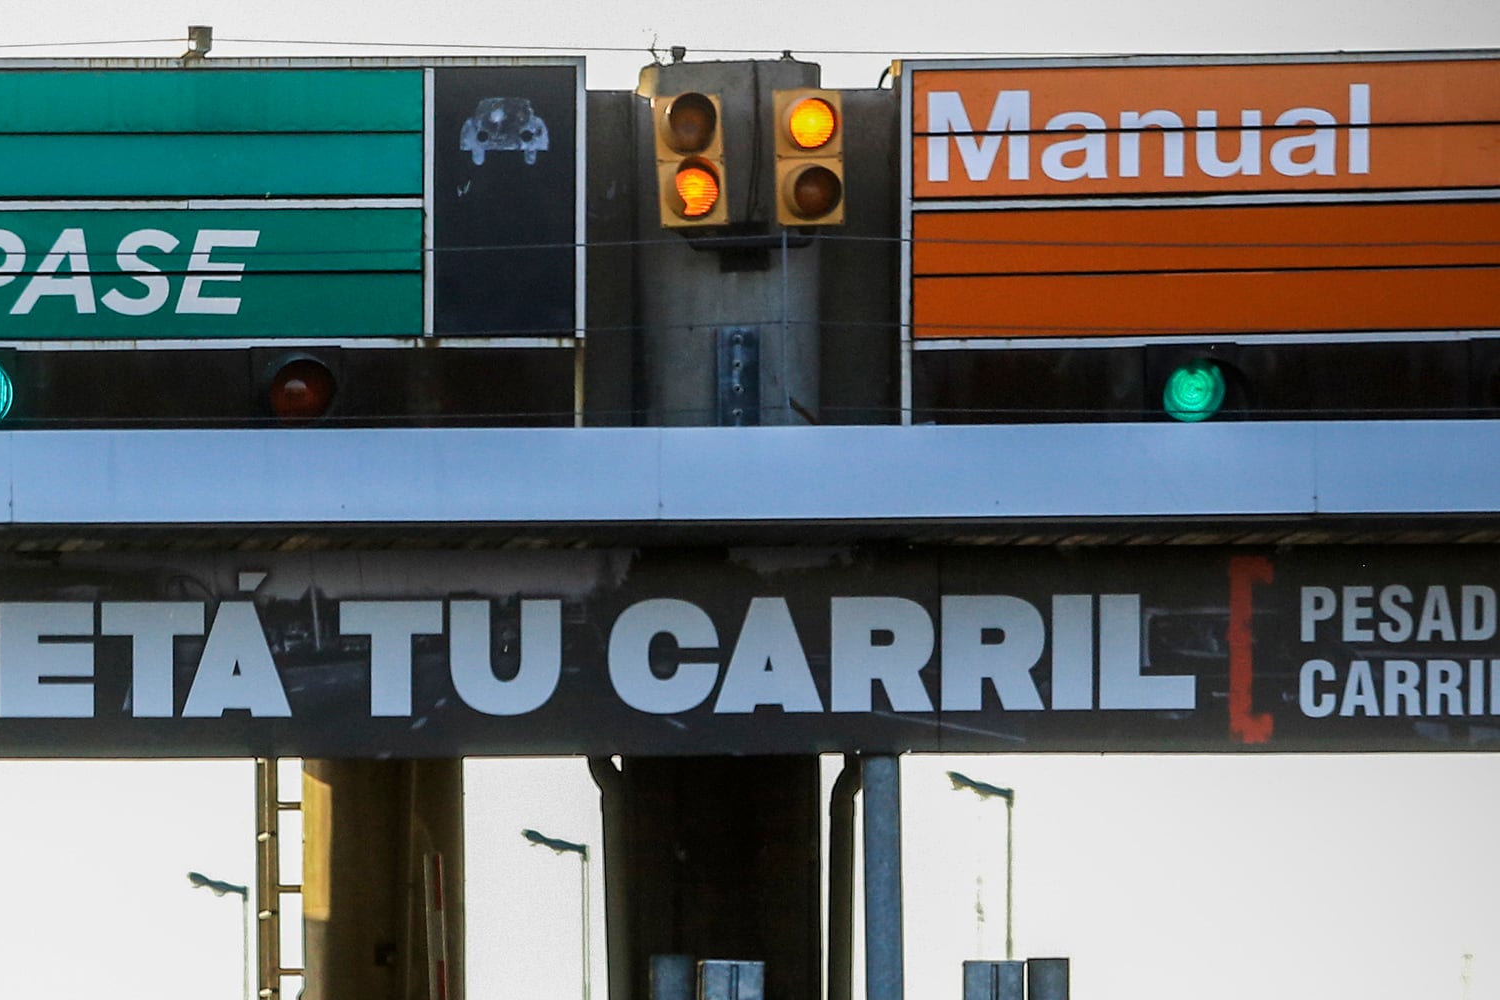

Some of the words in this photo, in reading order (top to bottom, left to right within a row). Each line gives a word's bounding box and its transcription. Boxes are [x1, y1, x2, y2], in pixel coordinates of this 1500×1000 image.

[928, 83, 1370, 182] Manual
[339, 599, 562, 718] TU
[608, 593, 1196, 715] CARRIL
